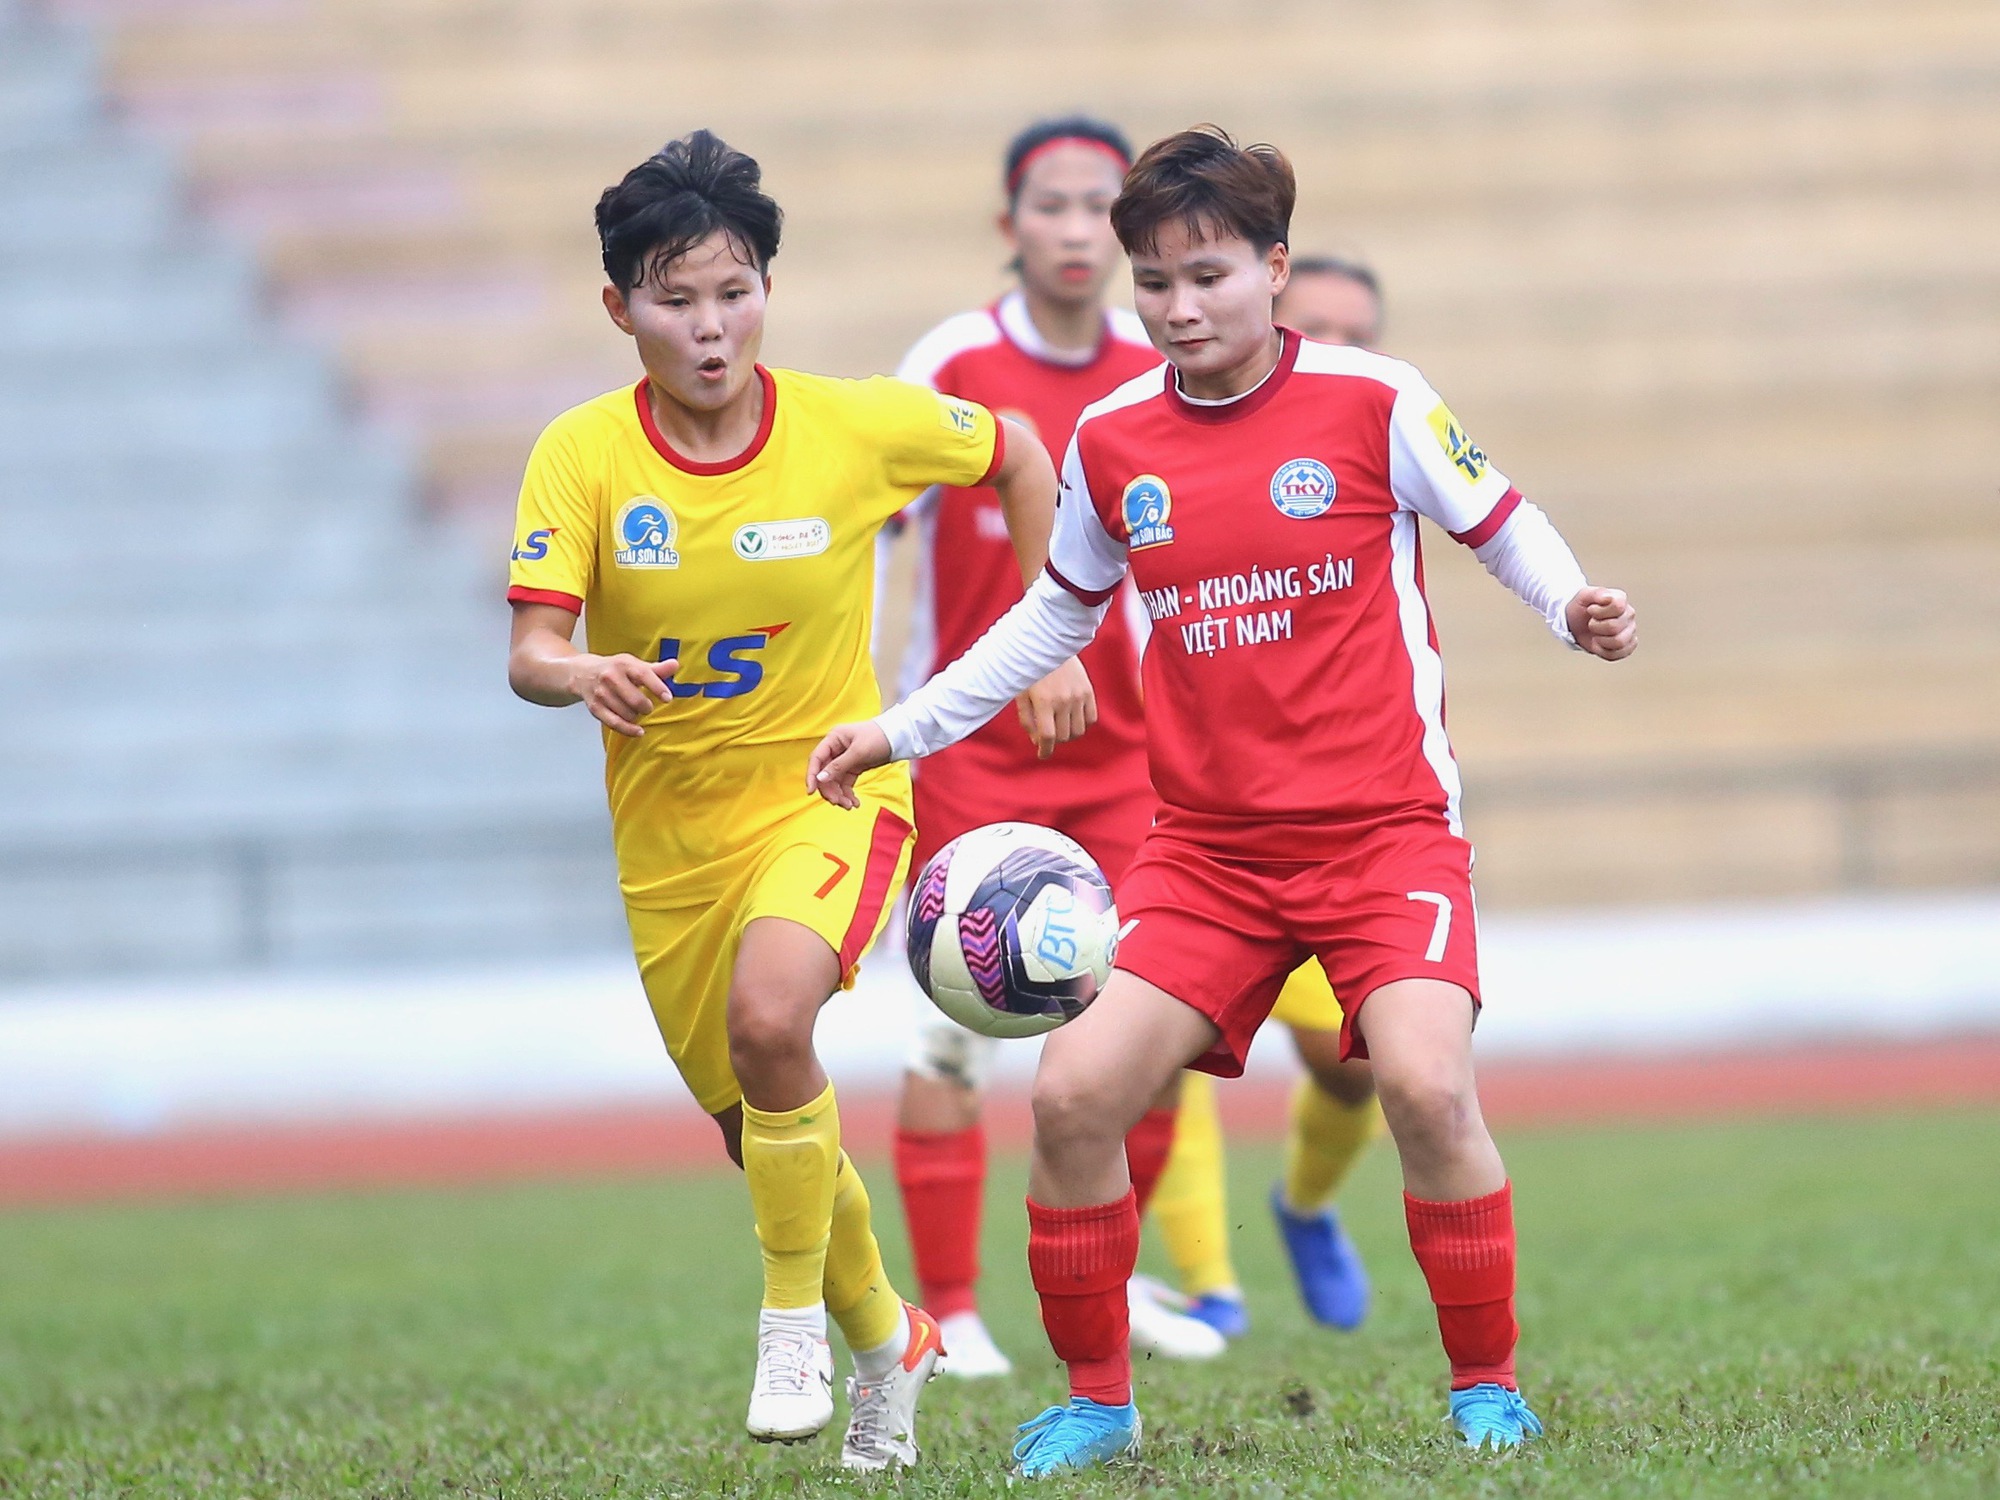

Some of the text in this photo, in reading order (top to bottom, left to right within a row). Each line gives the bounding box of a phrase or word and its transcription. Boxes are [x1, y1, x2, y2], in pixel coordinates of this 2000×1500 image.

[1282, 484, 1325, 495] TKV
[616, 548, 636, 563] THÁI
[637, 547, 656, 563] SƠN
[1199, 564, 1302, 610] KHOÁNG
[1307, 553, 1354, 595] SẢN
[1181, 609, 1292, 657] VIỆT NAM
[659, 633, 767, 699] LS
[813, 852, 850, 900] 7
[1037, 894, 1077, 971] BTC
[1406, 890, 1453, 963] 7
